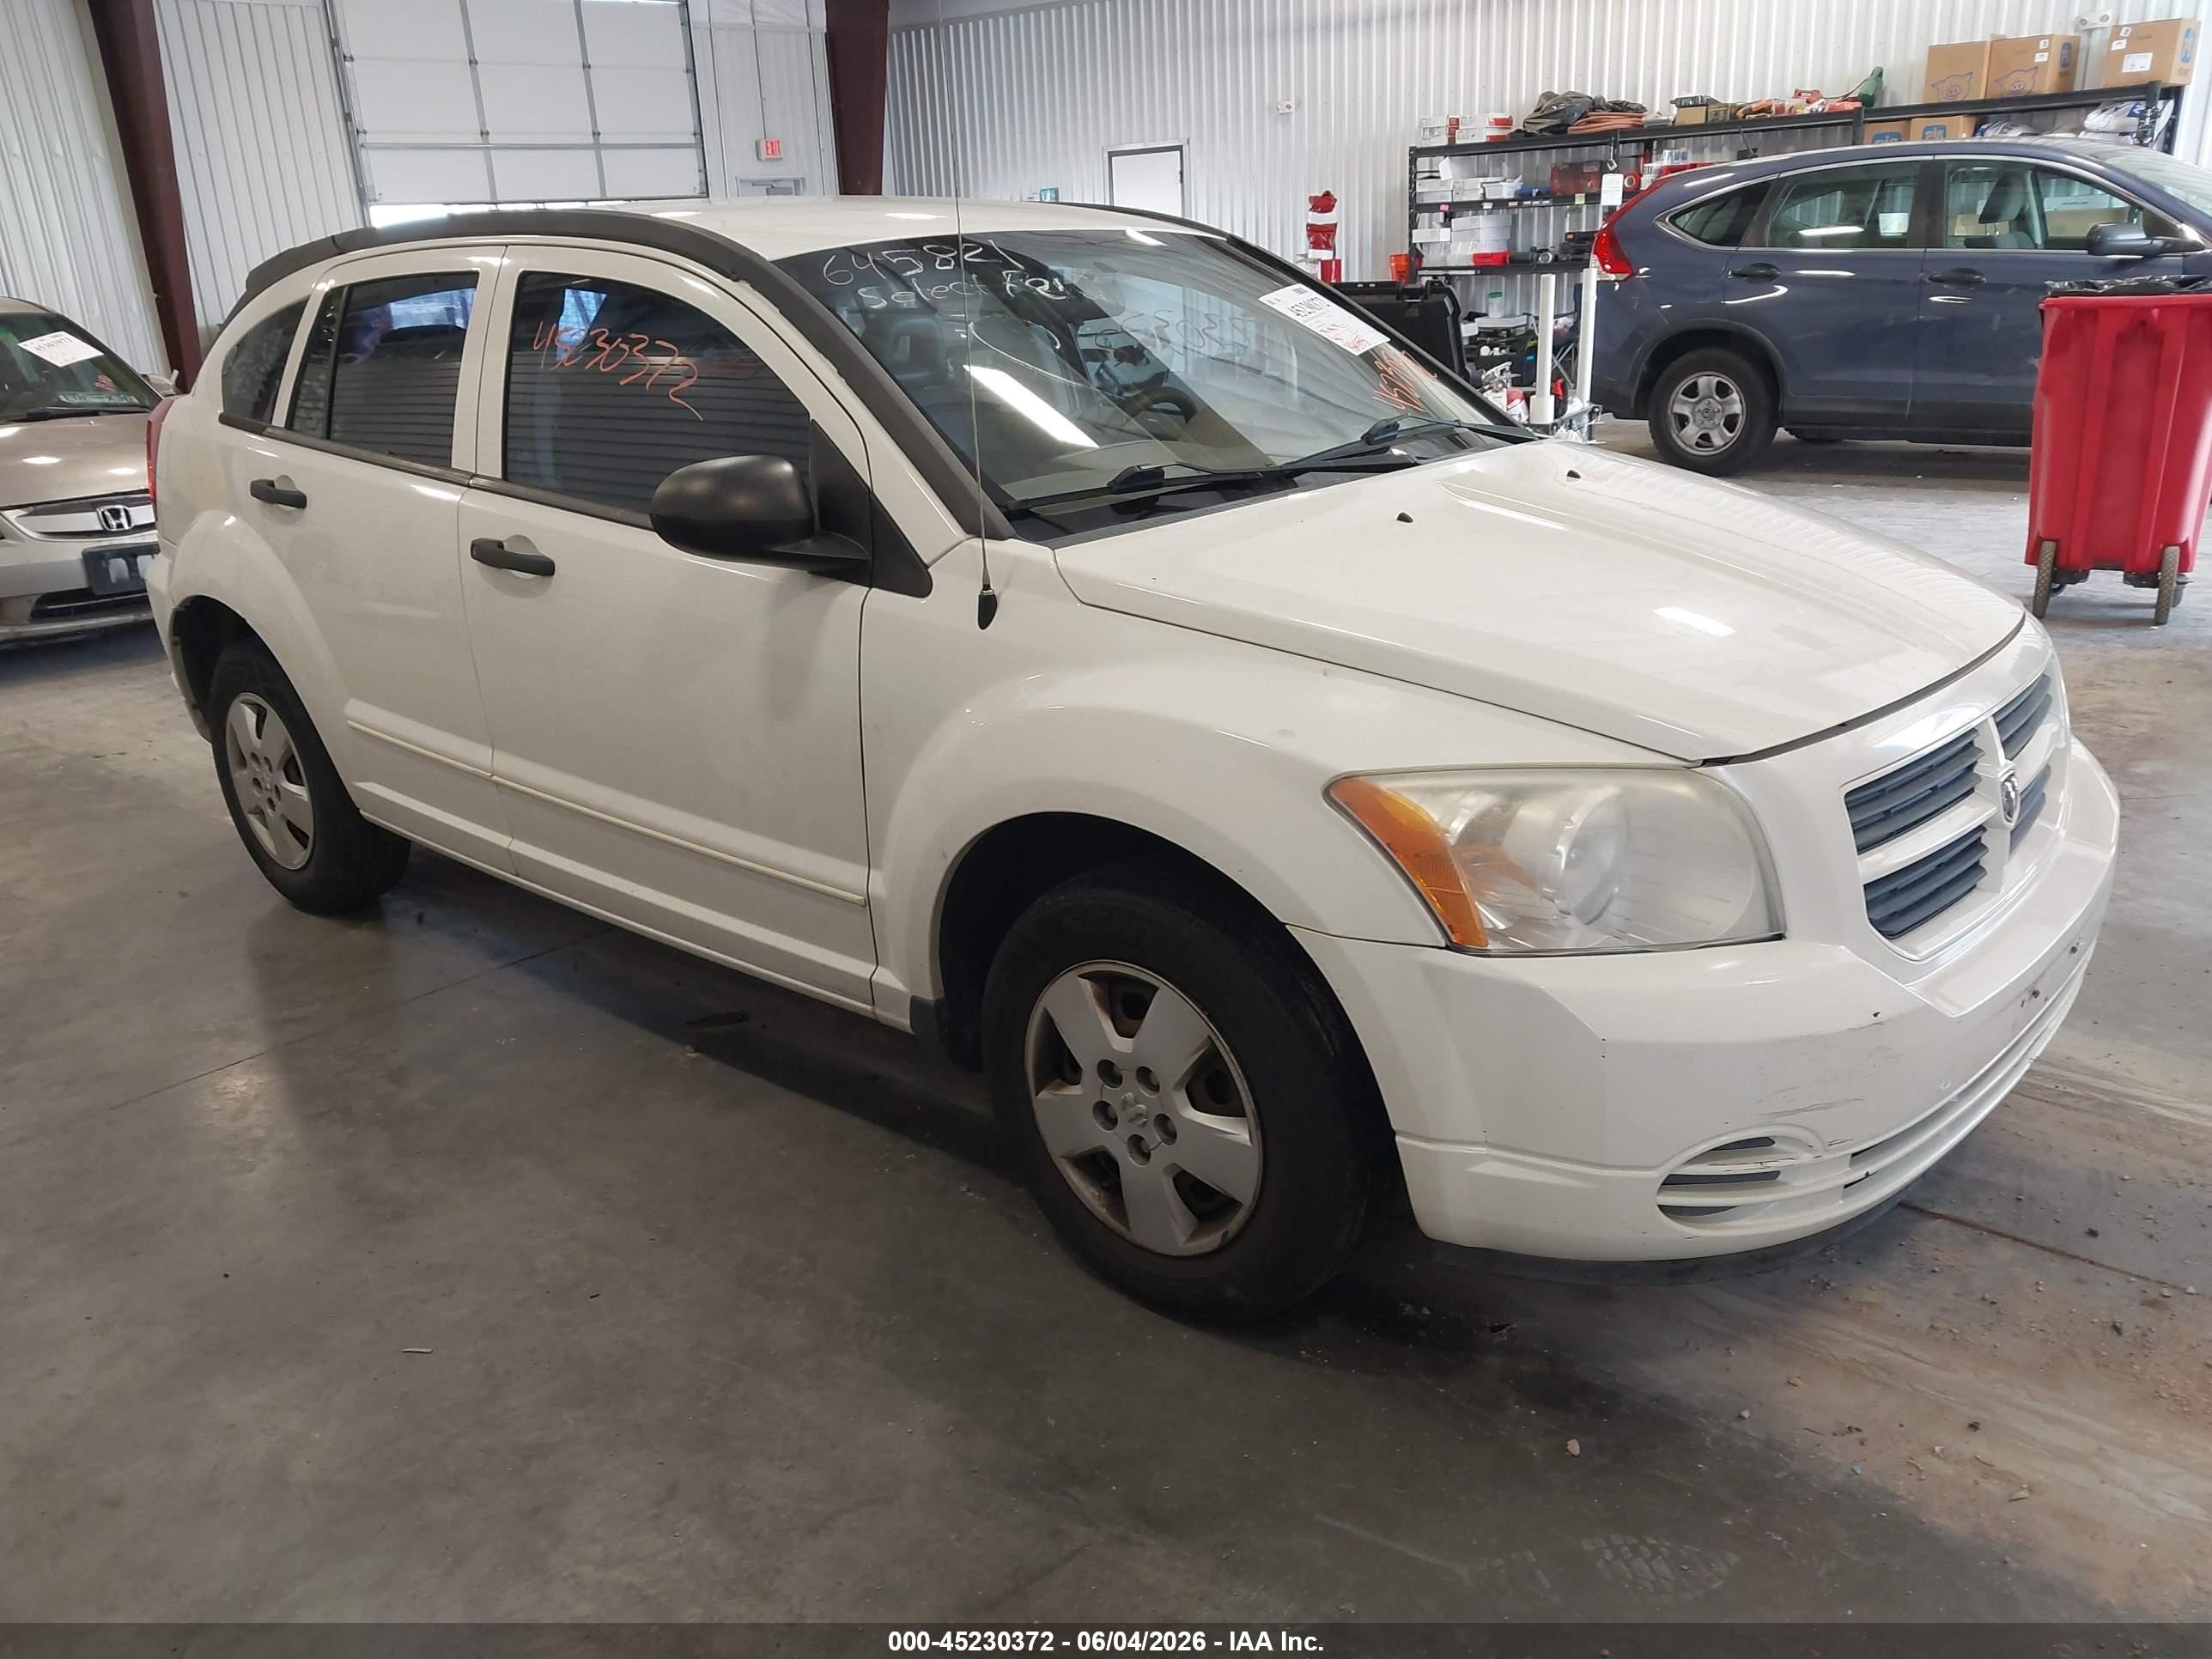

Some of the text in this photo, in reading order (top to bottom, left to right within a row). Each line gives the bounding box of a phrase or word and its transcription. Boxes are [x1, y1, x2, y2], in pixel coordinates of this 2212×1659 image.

[823, 239, 1025, 285] 645821
[857, 276, 989, 309] Select
[533, 320, 704, 422] 45230372
